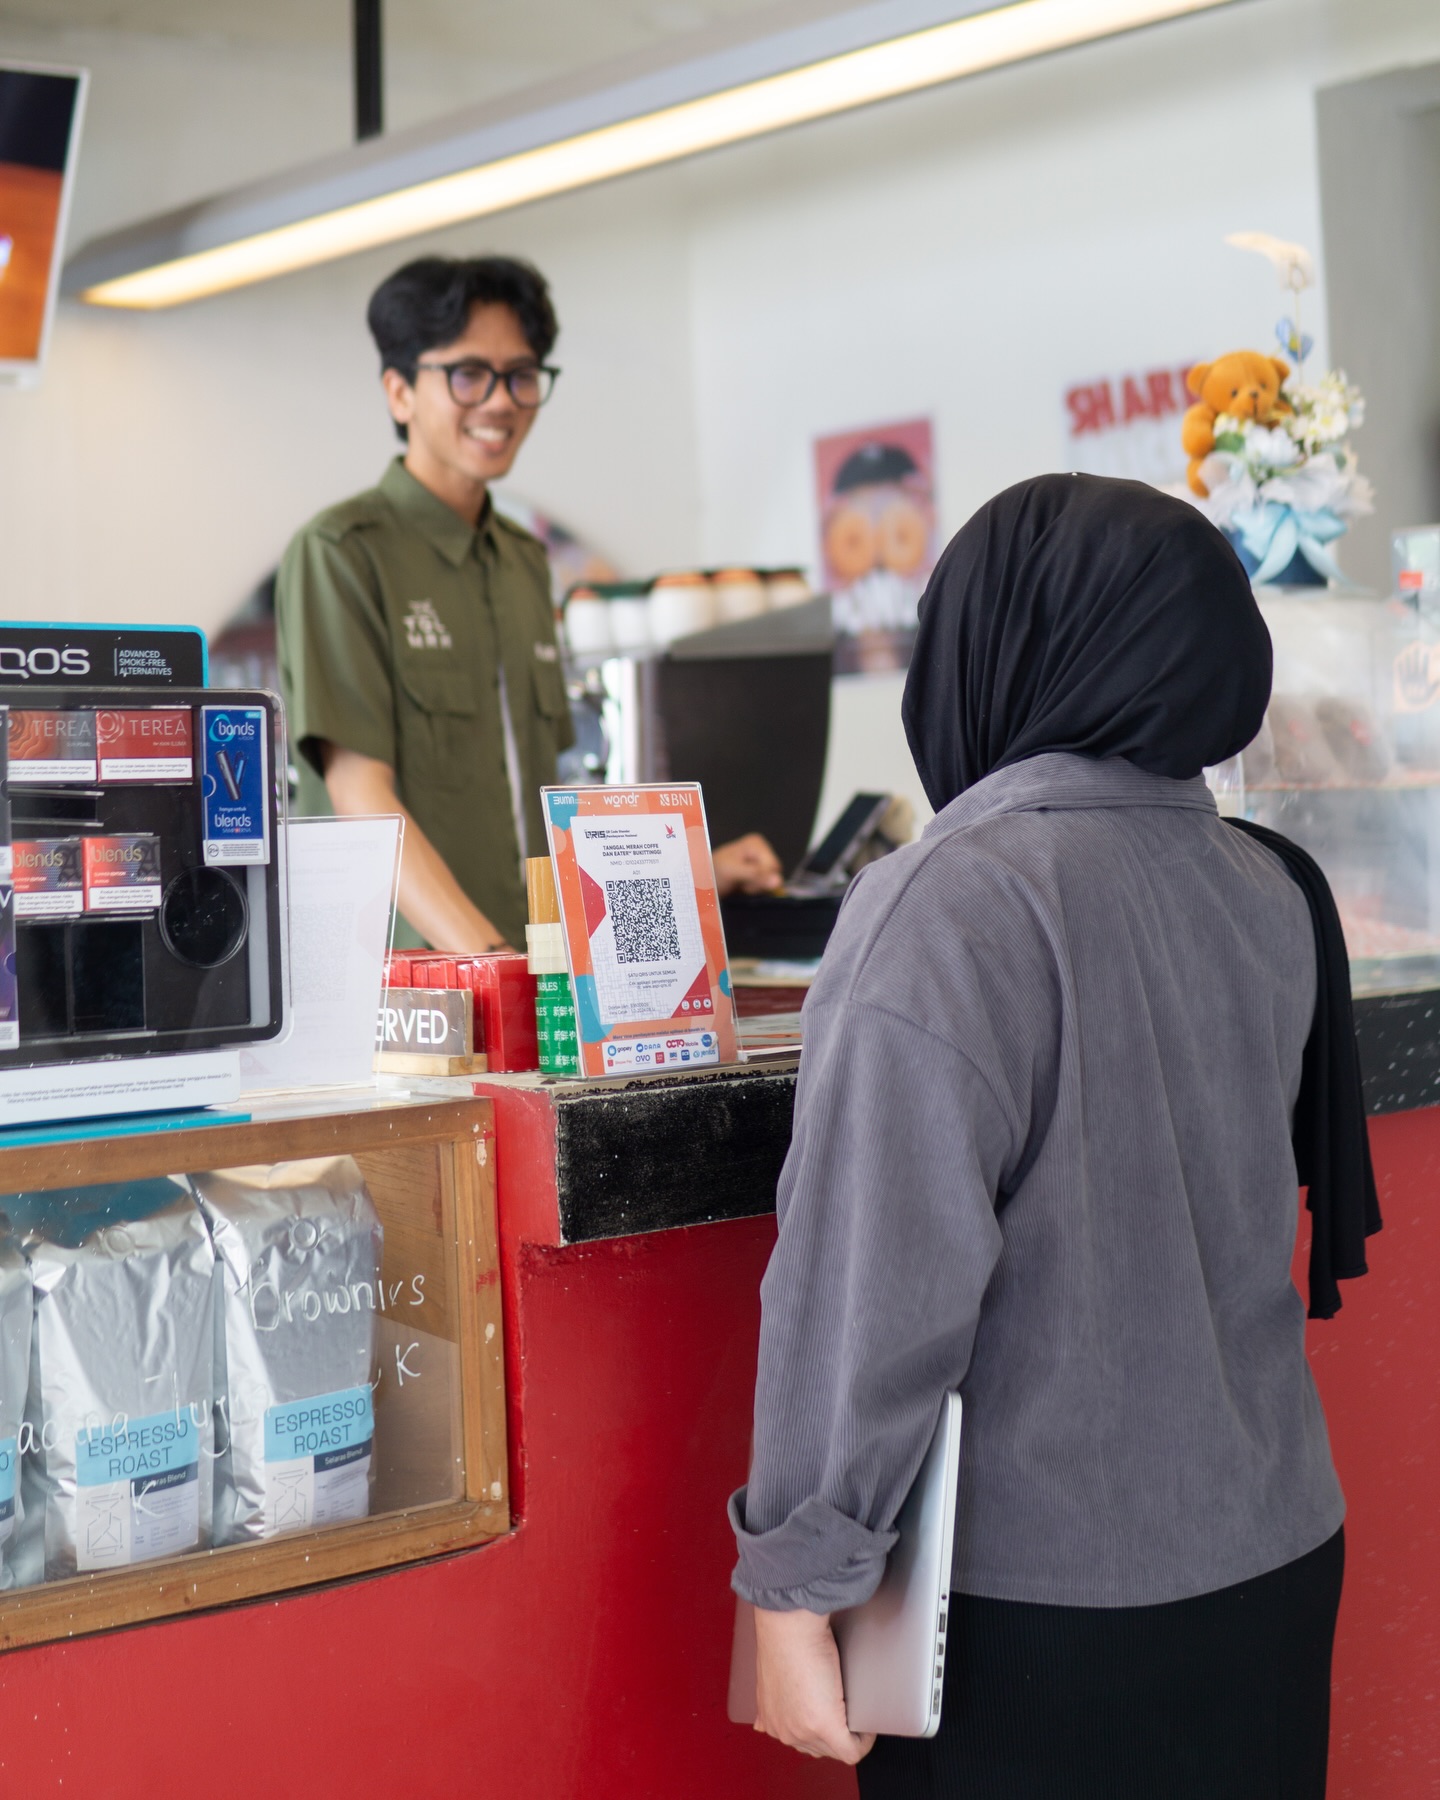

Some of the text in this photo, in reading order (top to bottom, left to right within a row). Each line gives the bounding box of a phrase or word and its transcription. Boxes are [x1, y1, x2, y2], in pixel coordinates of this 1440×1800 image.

[119, 650, 160, 658] ADVANCED
[119, 658, 166, 667] SMOKE-FREE
[119, 667, 172, 676] ALTERNATIVES
[32, 720, 91, 737] TEREA
[129, 719, 187, 736] TEREA
[218, 722, 255, 736] bonds
[603, 793, 639, 806] wondr
[671, 793, 693, 806] BNI
[214, 813, 252, 828] blends
[91, 845, 143, 863] blends
[666, 1039, 685, 1048] OCTO
[635, 1054, 651, 1063] OVO
[275, 1397, 367, 1435] ESPRESSO
[88, 1418, 188, 1458] ESPRESSO
[294, 1423, 353, 1454] ROAST
[109, 1446, 172, 1477] ROAST
